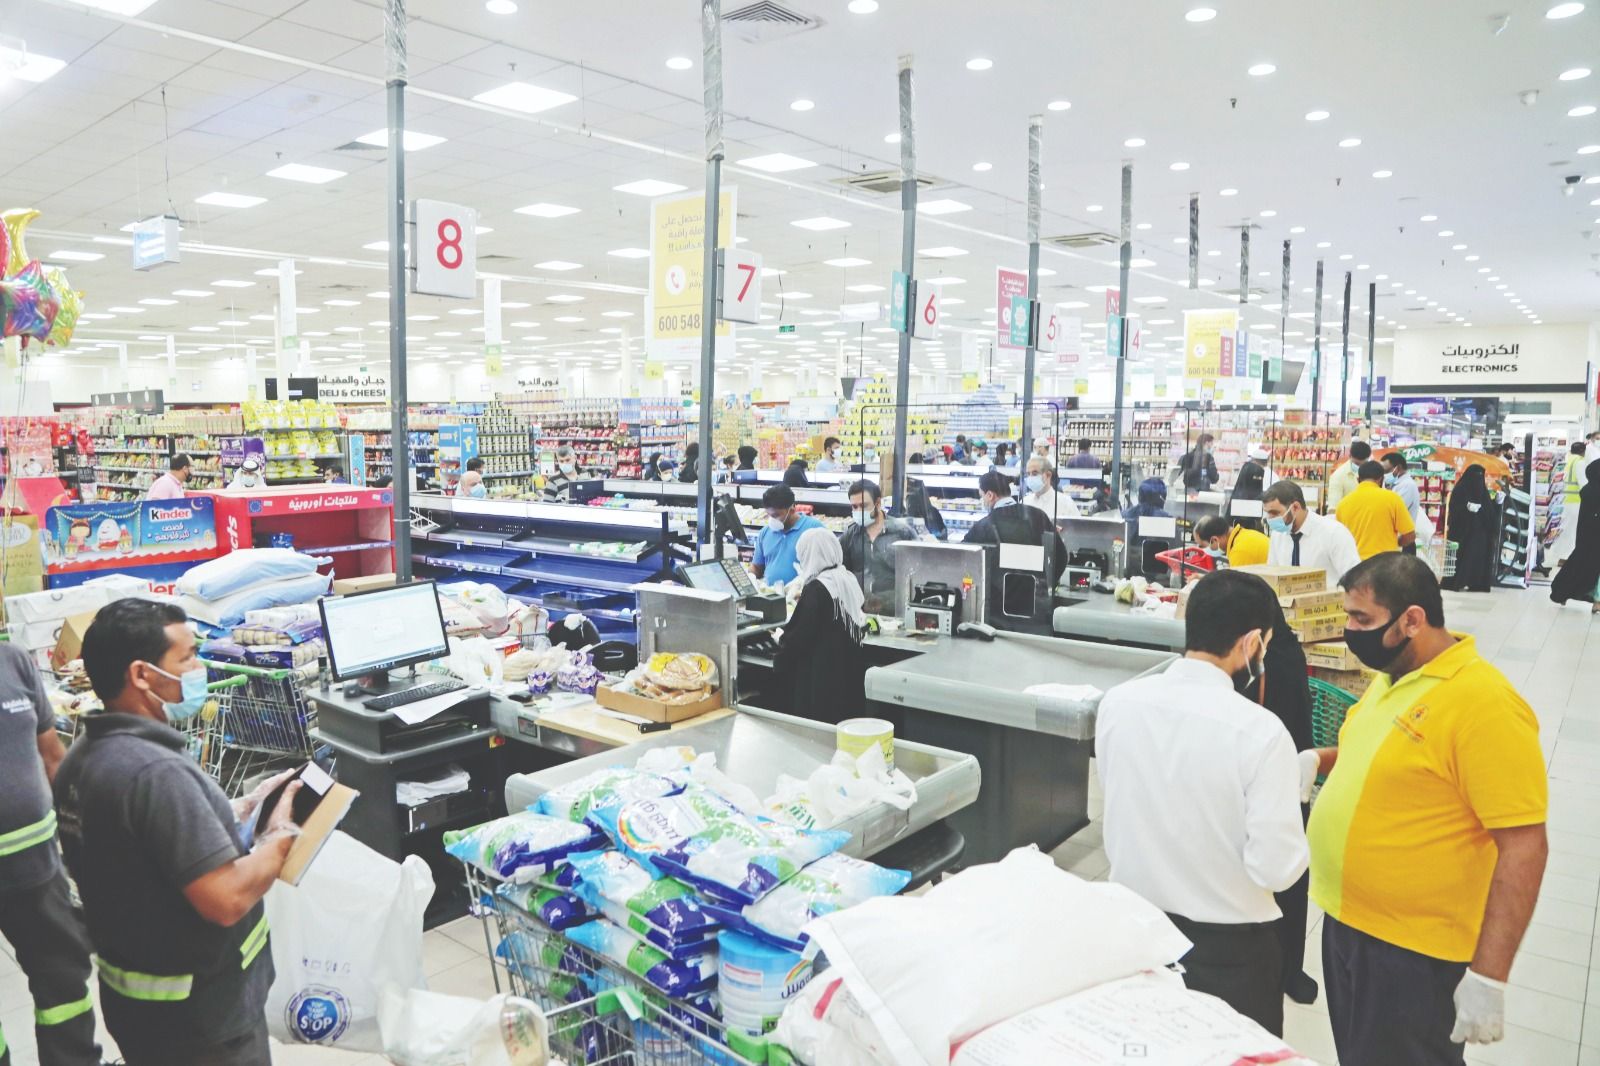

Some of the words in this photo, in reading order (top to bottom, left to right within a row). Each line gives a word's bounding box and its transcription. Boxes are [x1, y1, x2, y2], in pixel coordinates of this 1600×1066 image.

[437, 218, 463, 270] 8
[738, 263, 757, 303] 7
[924, 294, 937, 325] 6
[658, 315, 678, 332] 600
[680, 313, 700, 330] 548
[1047, 314, 1057, 341] 5
[1132, 329, 1140, 350] 4
[1442, 343, 1520, 359] إلكترونيات
[1441, 364, 1518, 373] ELECTRONICS
[319, 389, 340, 397] DELI
[324, 495, 359, 507] منتجات
[151, 509, 190, 520] Kinder
